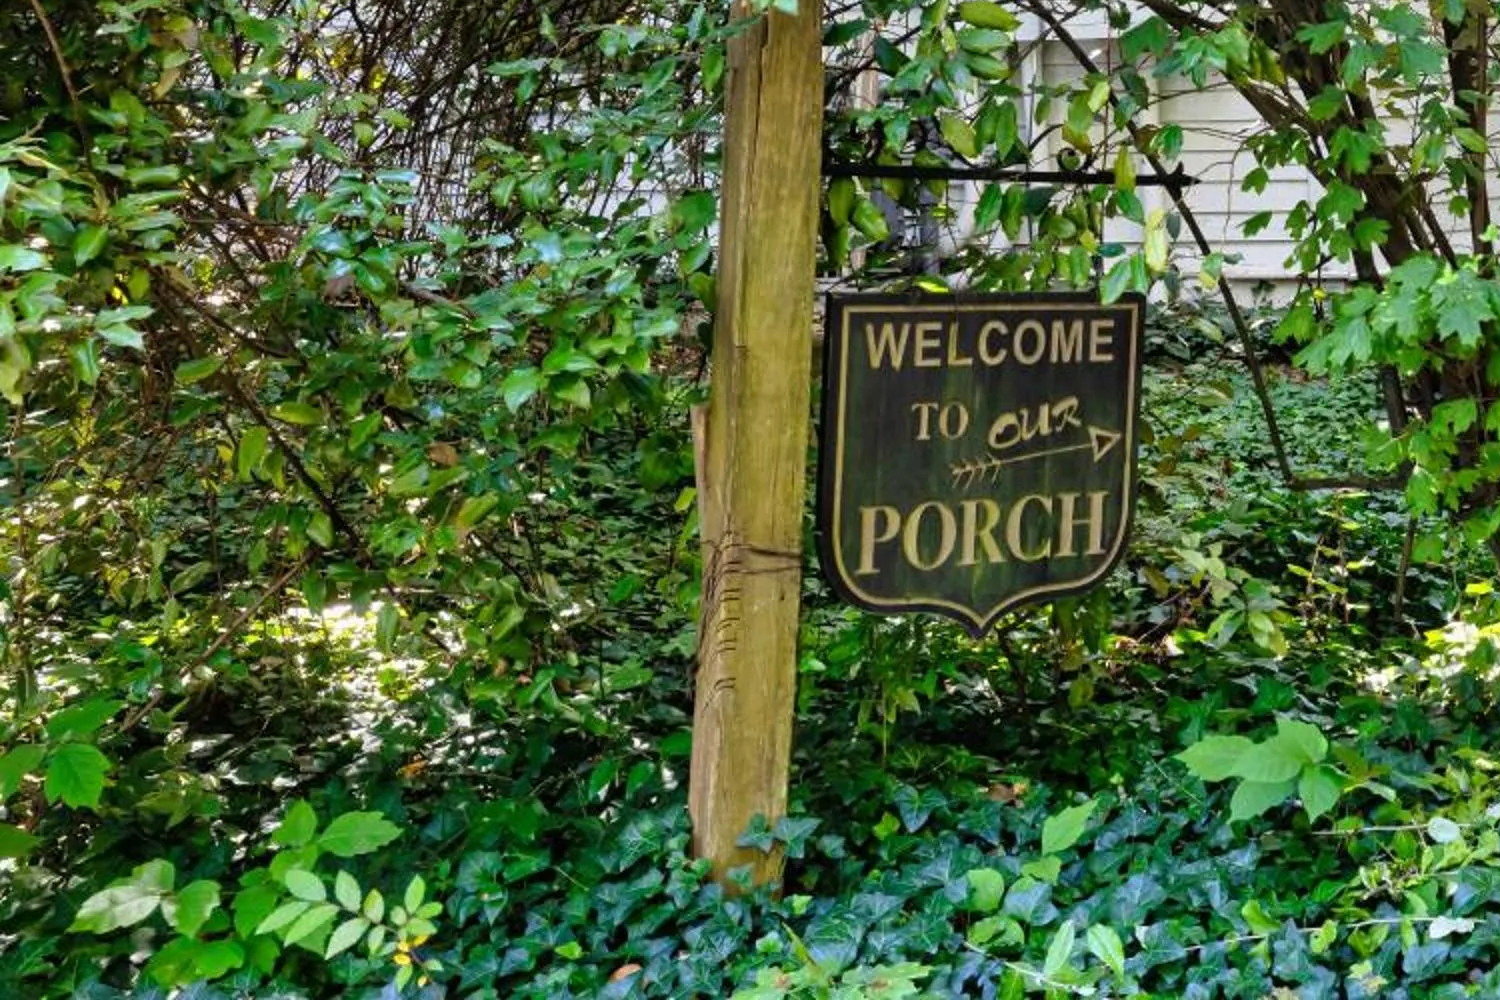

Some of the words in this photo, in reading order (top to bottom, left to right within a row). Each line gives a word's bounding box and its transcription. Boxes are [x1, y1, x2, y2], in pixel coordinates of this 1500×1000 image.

[864, 318, 1116, 372] WELCOME
[911, 402, 970, 441] TO
[854, 490, 1109, 576] PORCH
